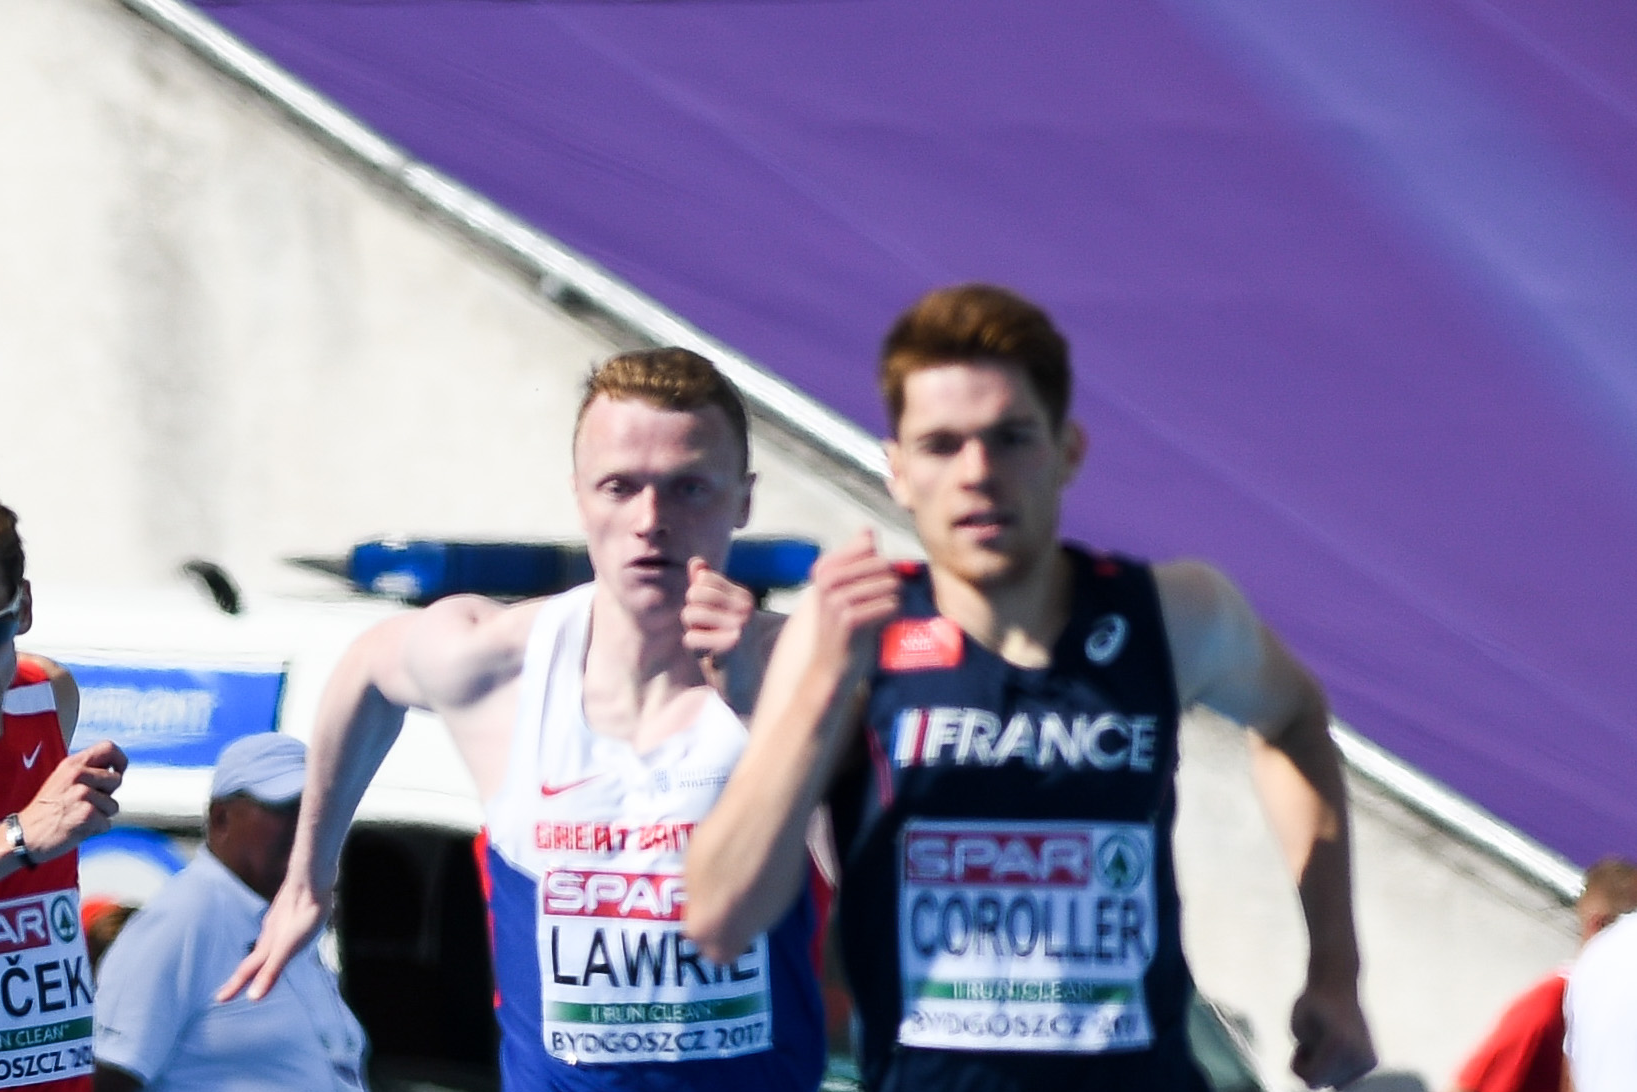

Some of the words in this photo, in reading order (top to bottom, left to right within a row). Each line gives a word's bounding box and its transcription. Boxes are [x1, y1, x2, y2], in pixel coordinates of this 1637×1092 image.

[923, 708, 1159, 772] FRANCE
[536, 821, 629, 851] GREAT
[908, 838, 1089, 882] SPAR
[910, 892, 1151, 960] COROLLER
[552, 1029, 707, 1053] BYDGOSZCZ
[713, 1022, 763, 1050] 2017
